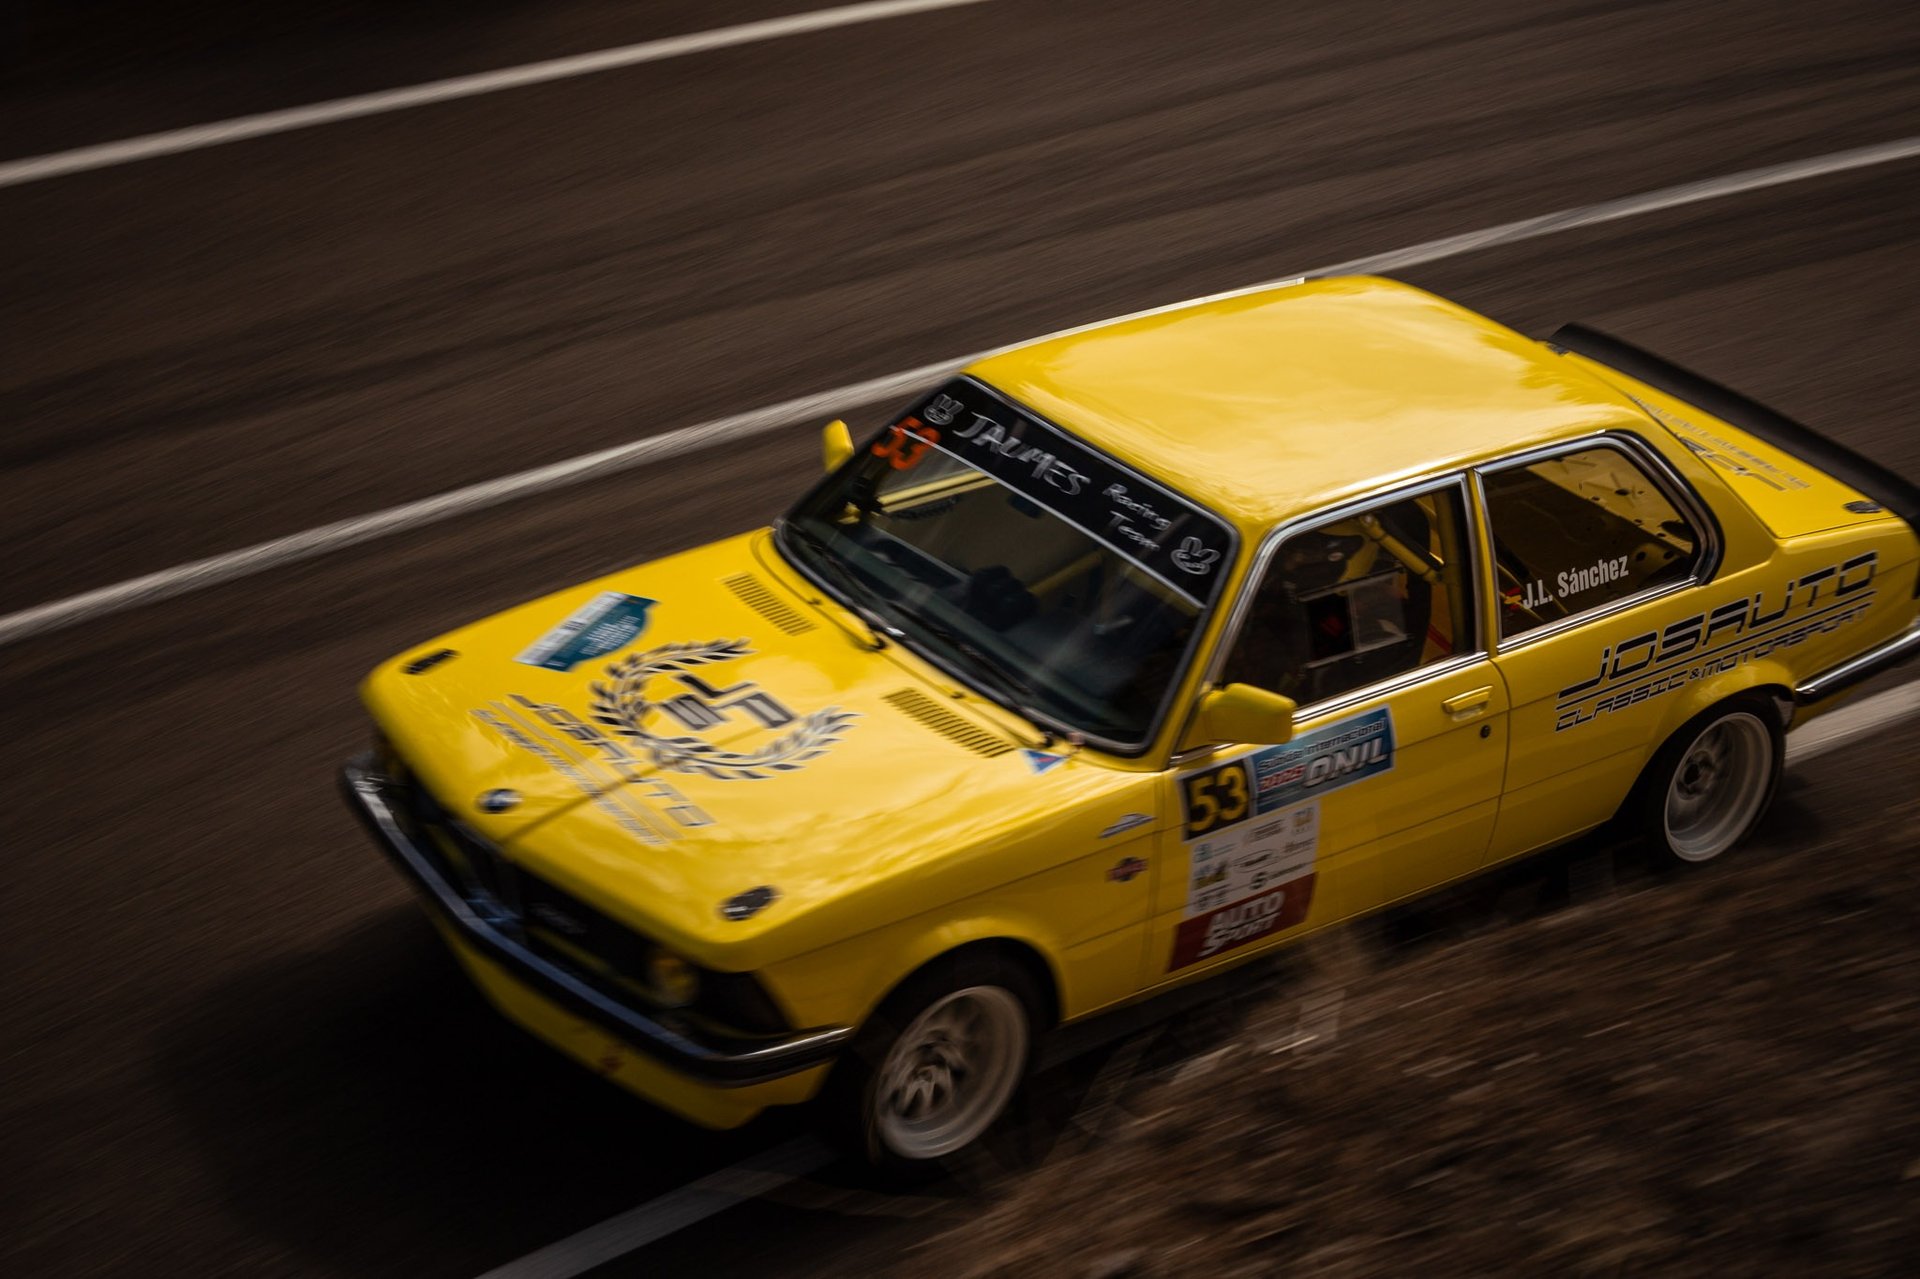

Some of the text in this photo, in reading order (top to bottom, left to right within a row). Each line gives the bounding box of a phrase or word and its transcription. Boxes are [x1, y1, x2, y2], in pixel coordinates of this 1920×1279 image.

[871, 416, 941, 471] 53
[953, 411, 1091, 496] JAUMES
[1102, 483, 1172, 531] Racing
[1107, 510, 1160, 552] Team
[1523, 555, 1629, 609] J.L. Sánchez
[1558, 550, 1878, 700] JOSAUTO
[1303, 736, 1388, 788] ONIL
[1188, 765, 1248, 832] 53
[1209, 890, 1285, 932] AUTO
